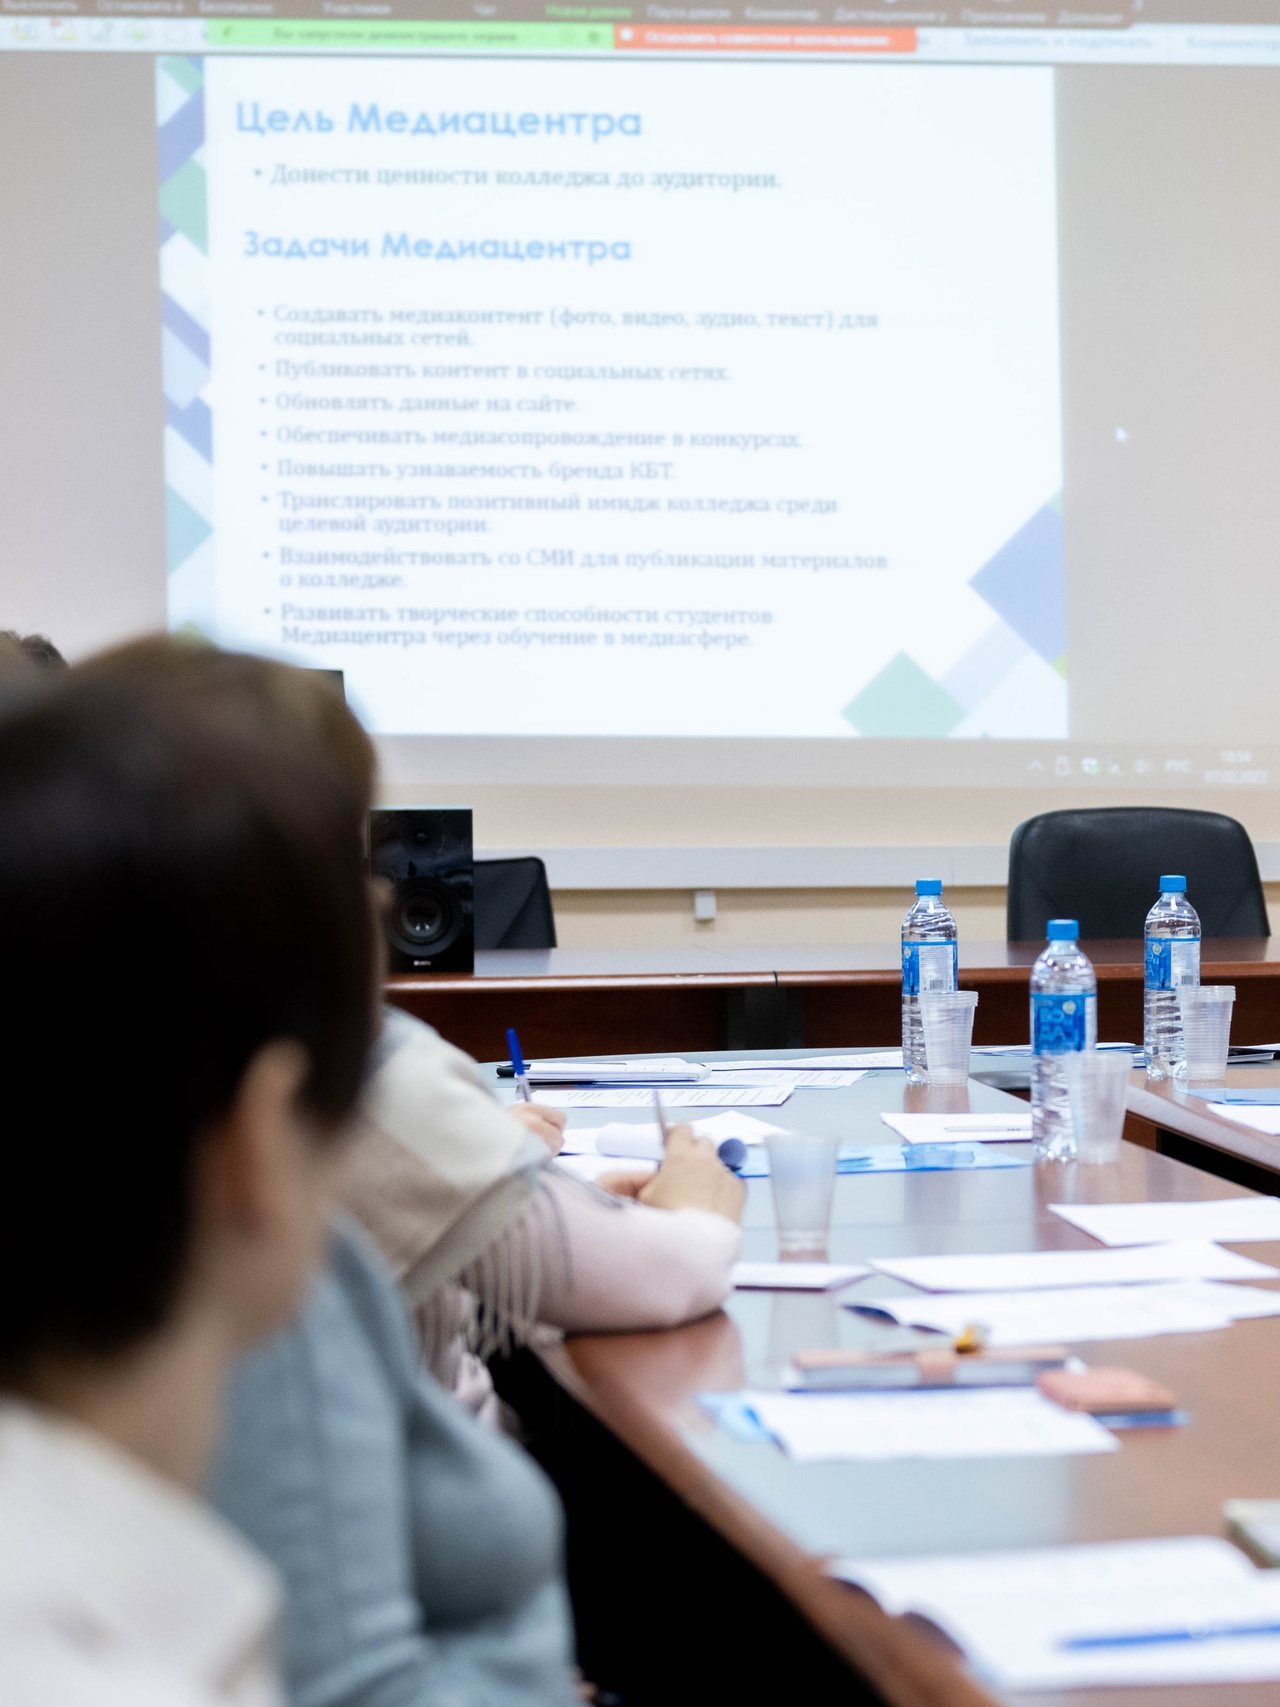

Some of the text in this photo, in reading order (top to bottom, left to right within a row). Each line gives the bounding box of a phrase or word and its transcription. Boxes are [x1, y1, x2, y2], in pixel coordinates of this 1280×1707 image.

[235, 100, 643, 144] Цель Медиацентра
[269, 162, 782, 195] Донести ценности колледжа до аудитории.
[243, 229, 632, 267] Задачи Медиацентра
[272, 303, 386, 326] Создавать
[388, 308, 545, 328] медиаконтент
[621, 311, 691, 329] видео,
[694, 311, 762, 331] аудио,
[765, 309, 835, 332] текст)
[837, 313, 879, 331] для
[273, 329, 475, 348] социальных сетей.
[274, 357, 731, 383] Публиковать контент в социальных сетях.
[275, 391, 580, 414] Обновлять данные на сайте.
[275, 425, 803, 453] Обеспечивать медиасопровождение в конкурсах.
[277, 457, 392, 479] Повышать
[395, 462, 545, 483] узнаваемость
[547, 460, 625, 484] бренда
[277, 489, 839, 518] Транслировать позитивный имидж колледжа среди
[278, 515, 493, 538] целевой аудитории.
[279, 545, 889, 574] Взаимодействовать со СМИ для публикации материалов
[278, 572, 406, 591] о колледже.
[280, 602, 774, 630] Развивать творческие способности студентов
[281, 627, 752, 652] Медиацентра через обучение в медиасфере.
